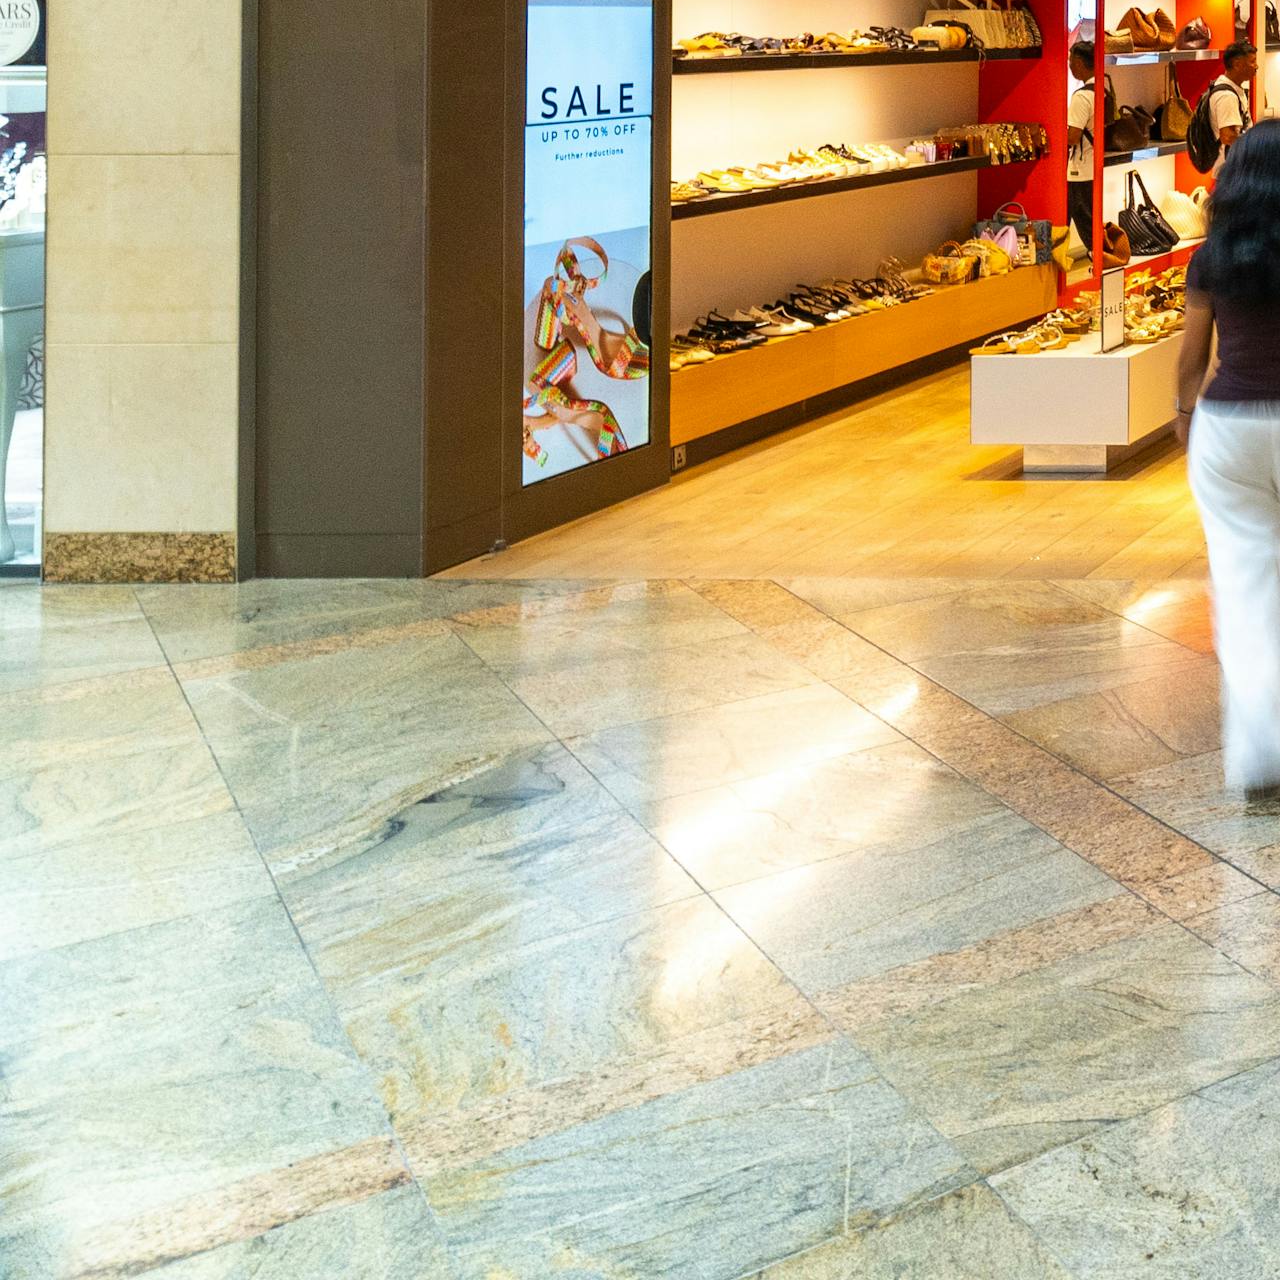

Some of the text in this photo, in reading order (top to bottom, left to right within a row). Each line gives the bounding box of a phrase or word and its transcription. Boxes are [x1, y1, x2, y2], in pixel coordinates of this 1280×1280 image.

[541, 83, 634, 119] SALE
[542, 124, 636, 142] UP TO 70% OFF
[555, 148, 624, 161] Further reductions
[1104, 302, 1122, 318] SALE
